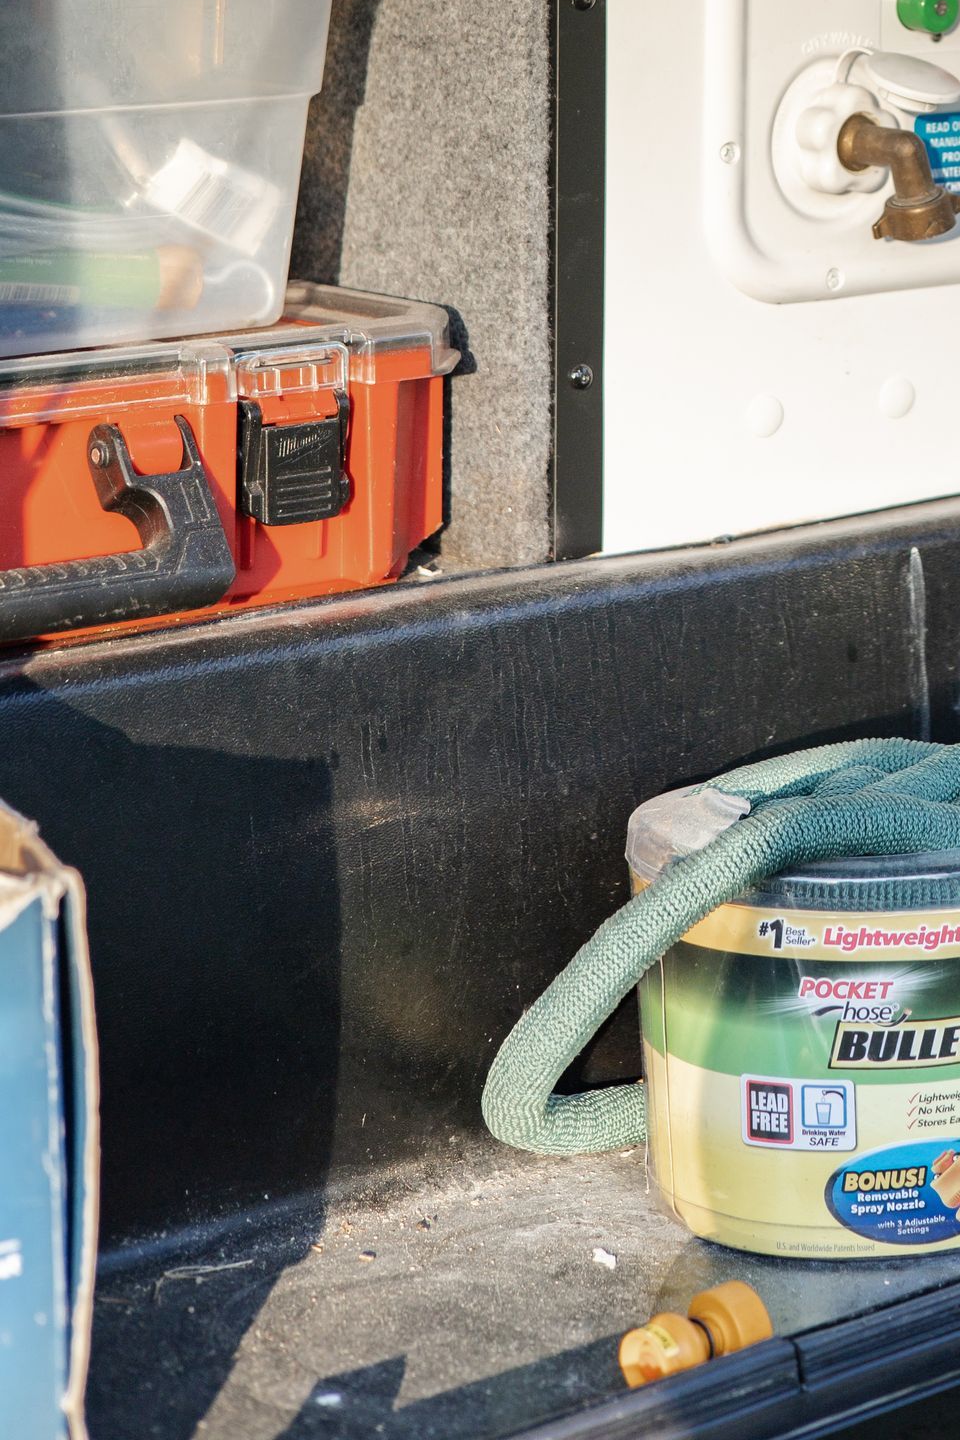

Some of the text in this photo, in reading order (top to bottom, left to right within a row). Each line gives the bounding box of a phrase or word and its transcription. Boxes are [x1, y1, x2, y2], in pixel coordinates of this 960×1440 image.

[925, 121, 950, 134] READ
[277, 429, 332, 458] Milwau
[758, 918, 784, 949] #1
[785, 926, 806, 937] Best
[799, 979, 894, 999] POCKET
[750, 1090, 789, 1113] LEAD
[918, 1103, 956, 1116] No Kink
[751, 1110, 789, 1133] FREE
[917, 1118, 947, 1128] Stores
[801, 1129, 846, 1138] Drinking Water
[809, 1137, 840, 1146] SAFE
[843, 1166, 927, 1192] BONUS!
[857, 1189, 919, 1202] Removable
[850, 1199, 925, 1216] Spray Nozzle
[877, 1220, 895, 1229] with
[904, 1215, 946, 1228] Adjustable
[897, 1226, 930, 1235] Settings
[789, 1242, 800, 1251] and
[800, 1242, 833, 1252] Worldwide
[833, 1243, 855, 1252] Patents
